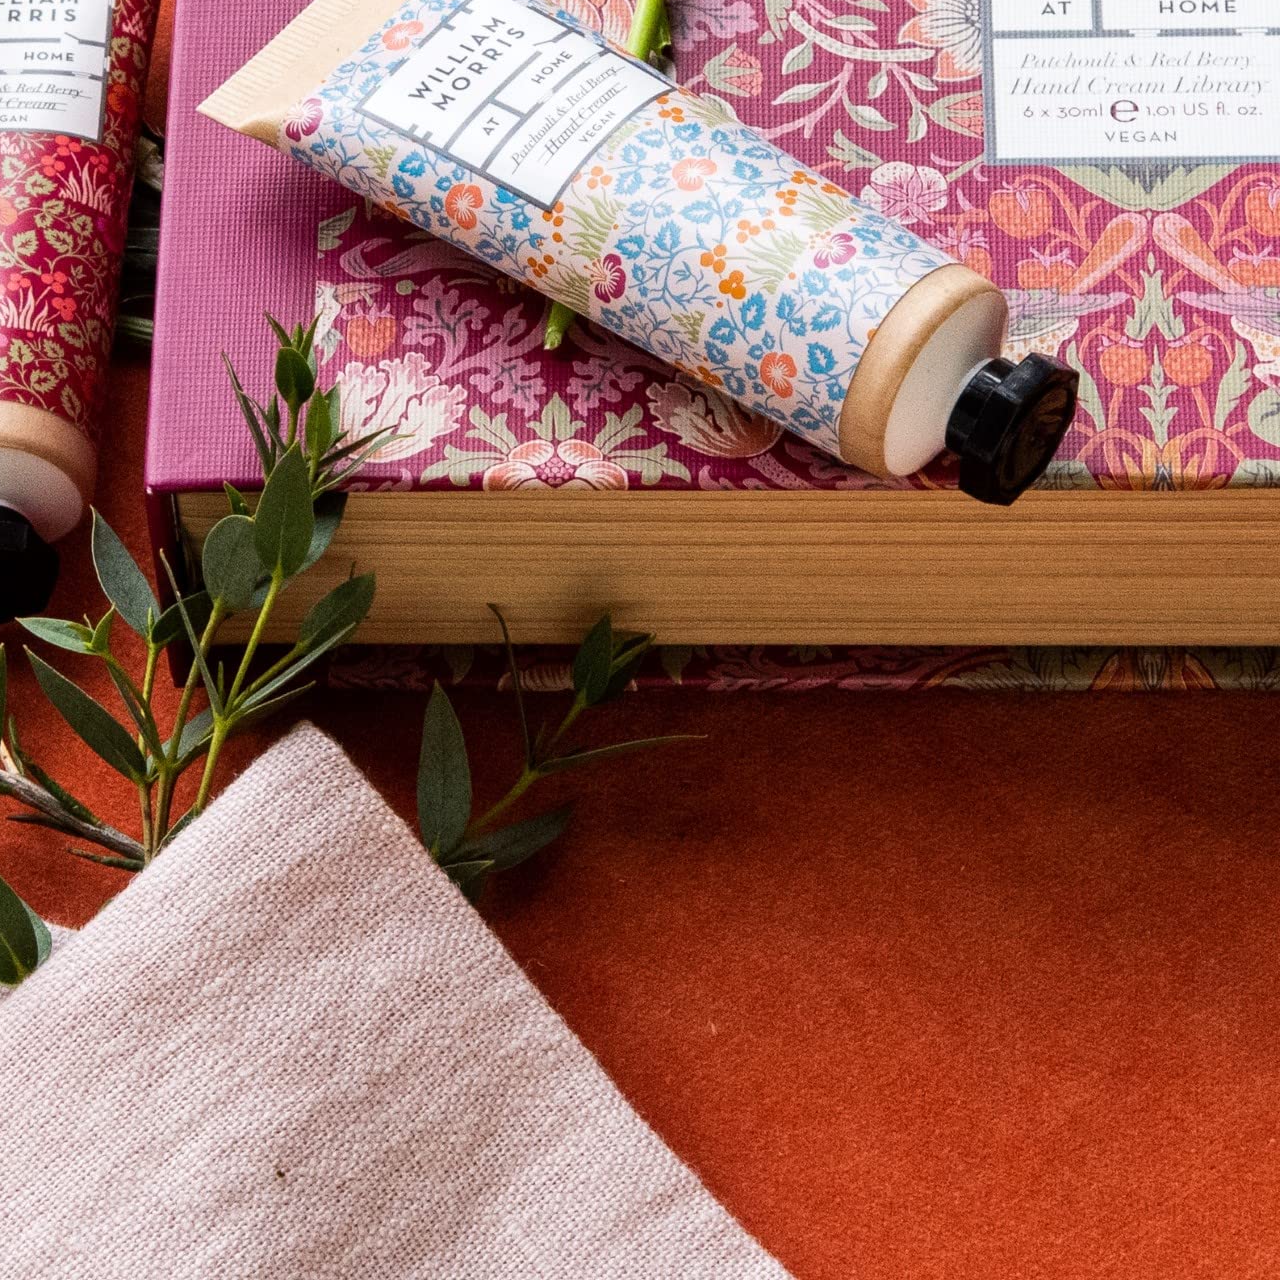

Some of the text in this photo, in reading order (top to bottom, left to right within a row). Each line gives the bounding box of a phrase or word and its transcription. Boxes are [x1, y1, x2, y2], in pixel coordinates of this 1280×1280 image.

[1041, 0, 1238, 15] AT HOME
[24, 51, 75, 62] HOME
[408, 16, 506, 101] WILLIAM
[1021, 52, 1252, 70] Patchouli & Red Berry
[431, 27, 525, 111] MORRIS
[0, 85, 9, 93] &
[15, 83, 42, 93] Red
[45, 83, 82, 98] Berry
[482, 50, 574, 136] AT HOME
[1009, 74, 1263, 98] Hand Cream Library
[6, 98, 57, 110] Cream
[1024, 106, 1033, 118] 6
[1040, 108, 1049, 117] x
[1057, 103, 1103, 118] 30ml
[1145, 106, 1176, 117] 1.01
[1184, 102, 1209, 116] US
[1216, 102, 1230, 115] fl.
[1237, 106, 1263, 115] oz.
[511, 116, 556, 168] Patchouli
[569, 83, 588, 107] Red
[588, 66, 618, 87] Berry
[544, 88, 621, 156] Hand Cream
[579, 110, 616, 144] VEGAN
[1104, 130, 1178, 143] VEGAN
